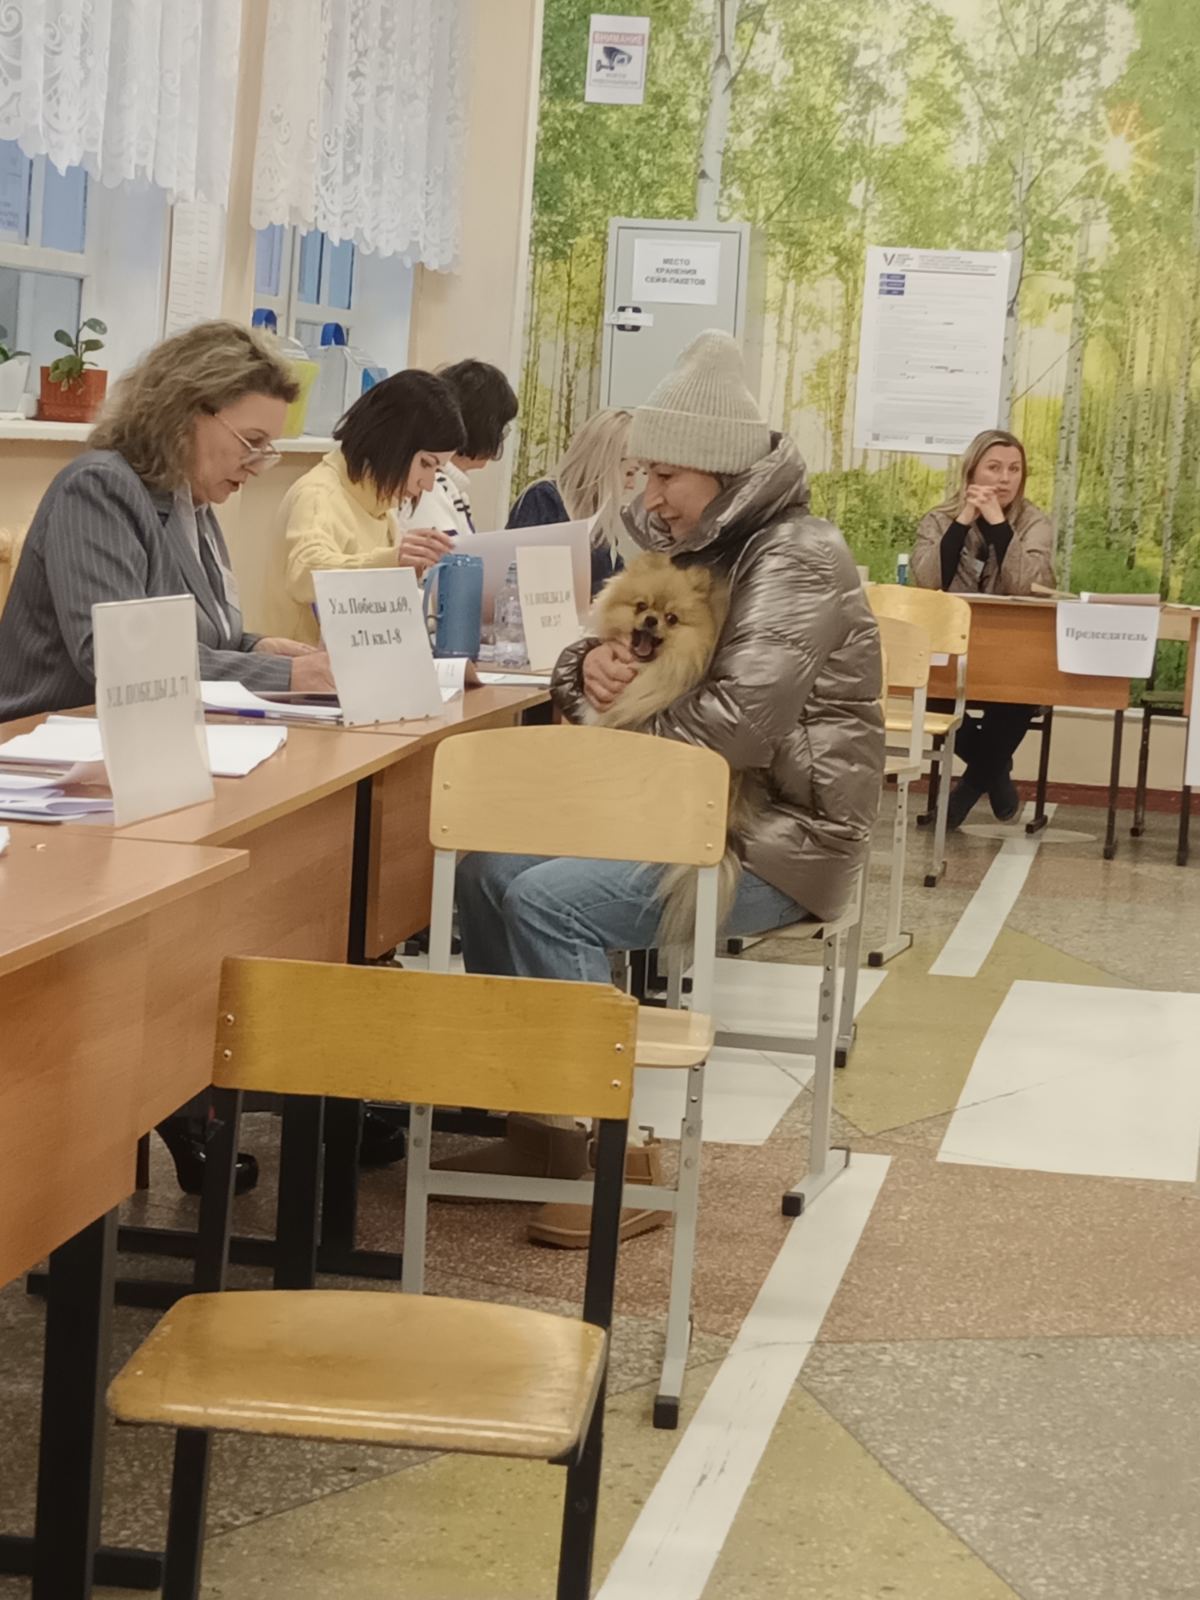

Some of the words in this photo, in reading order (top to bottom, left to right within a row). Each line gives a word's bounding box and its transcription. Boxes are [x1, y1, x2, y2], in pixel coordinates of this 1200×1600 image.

[663, 257, 691, 266] МЕСТО
[656, 267, 697, 275] ХРАНЕНИЯ
[644, 275, 706, 286] СЕЙФ-ПАКЕТОВ
[328, 597, 348, 615] Ул.
[348, 597, 386, 614] Победы
[1065, 626, 1148, 642] Председатель
[125, 678, 167, 705] ПОБЕДЫ
